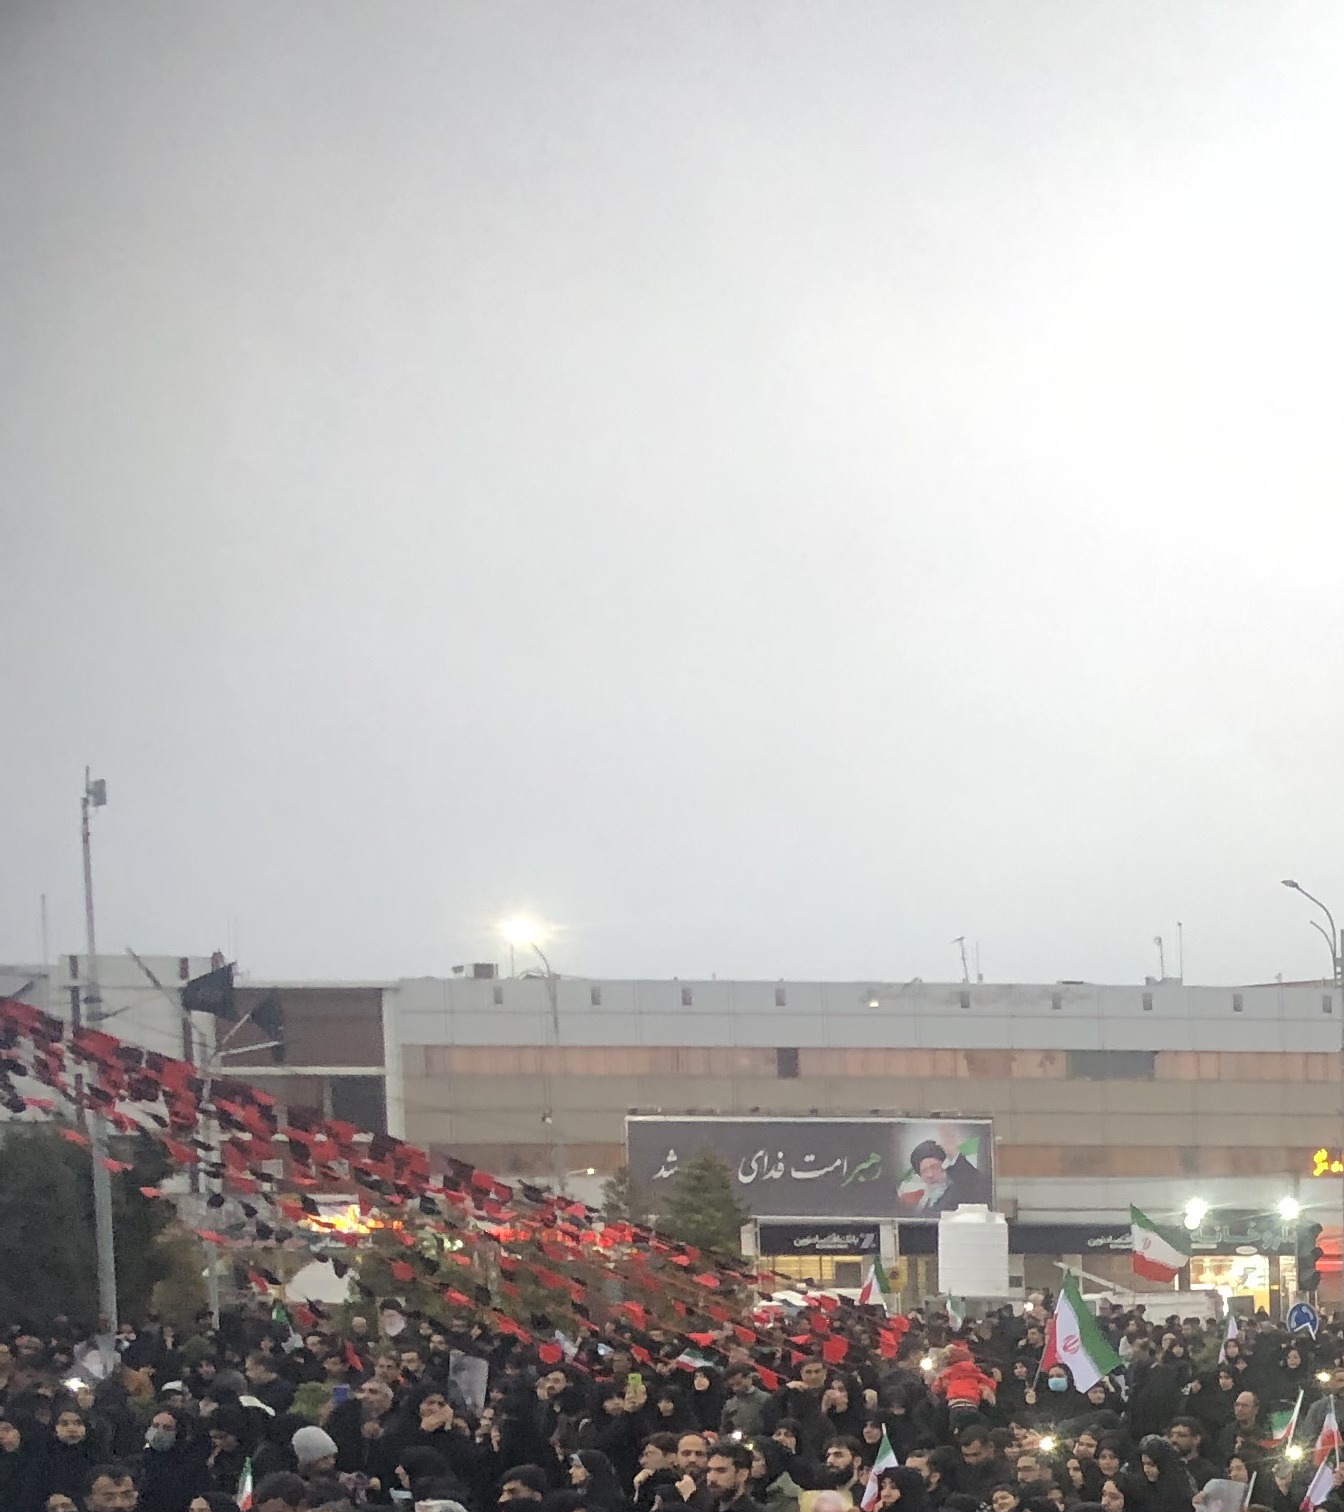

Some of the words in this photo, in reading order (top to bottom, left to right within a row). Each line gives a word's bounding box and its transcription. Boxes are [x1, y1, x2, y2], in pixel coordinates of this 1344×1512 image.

[652, 1149, 679, 1180] شد
[738, 1150, 785, 1184] فدای
[790, 1154, 848, 1179] امت
[840, 1152, 882, 1188] رهبر
